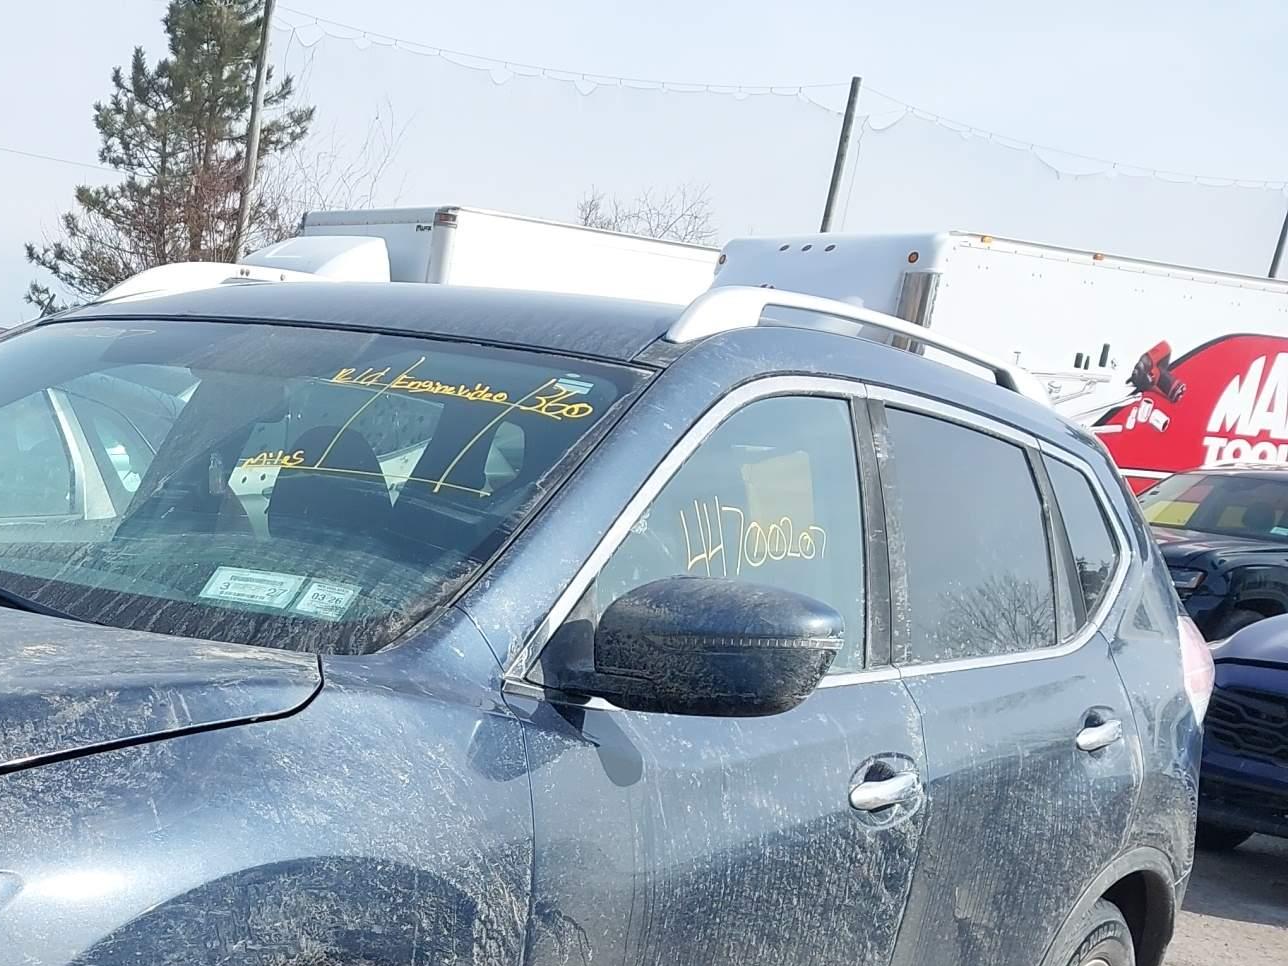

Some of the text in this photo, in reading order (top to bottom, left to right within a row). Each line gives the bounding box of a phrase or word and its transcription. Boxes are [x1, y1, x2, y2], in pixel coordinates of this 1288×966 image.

[520, 382, 594, 418] 360
[679, 495, 827, 577] 44700207
[265, 587, 289, 599] 27
